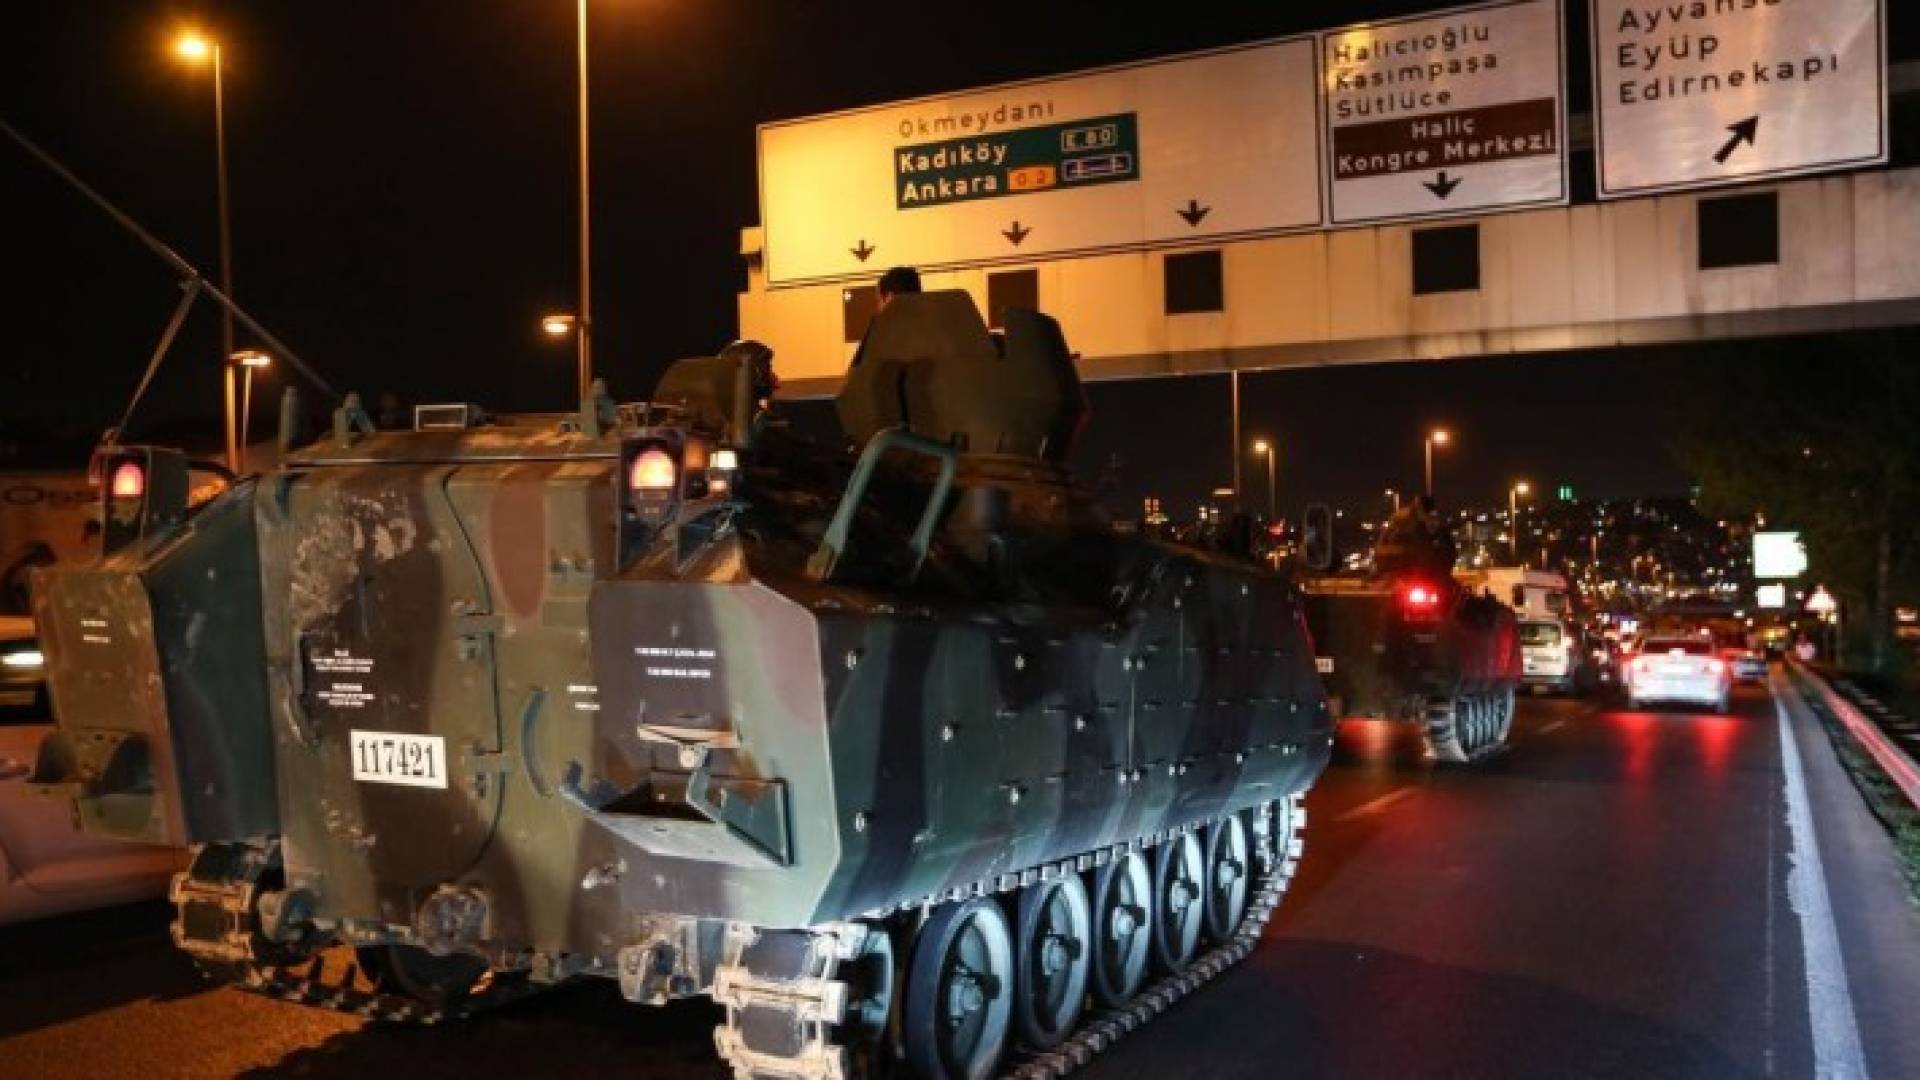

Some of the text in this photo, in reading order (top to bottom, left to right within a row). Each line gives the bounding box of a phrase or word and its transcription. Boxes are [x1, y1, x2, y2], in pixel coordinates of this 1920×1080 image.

[1616, 34, 1719, 71] Eyüp
[1335, 53, 1498, 92] Kasımpaşa
[1618, 53, 1838, 105] Edirnekapı
[898, 101, 1055, 139] Okmeydanı
[1335, 90, 1451, 119] Sütlüce
[1411, 115, 1477, 140] Haliç
[900, 142, 1008, 174] Kadıköy
[1338, 128, 1552, 175] Kongre Merkezi
[903, 174, 998, 202] Ankara
[357, 738, 437, 779] 117421
